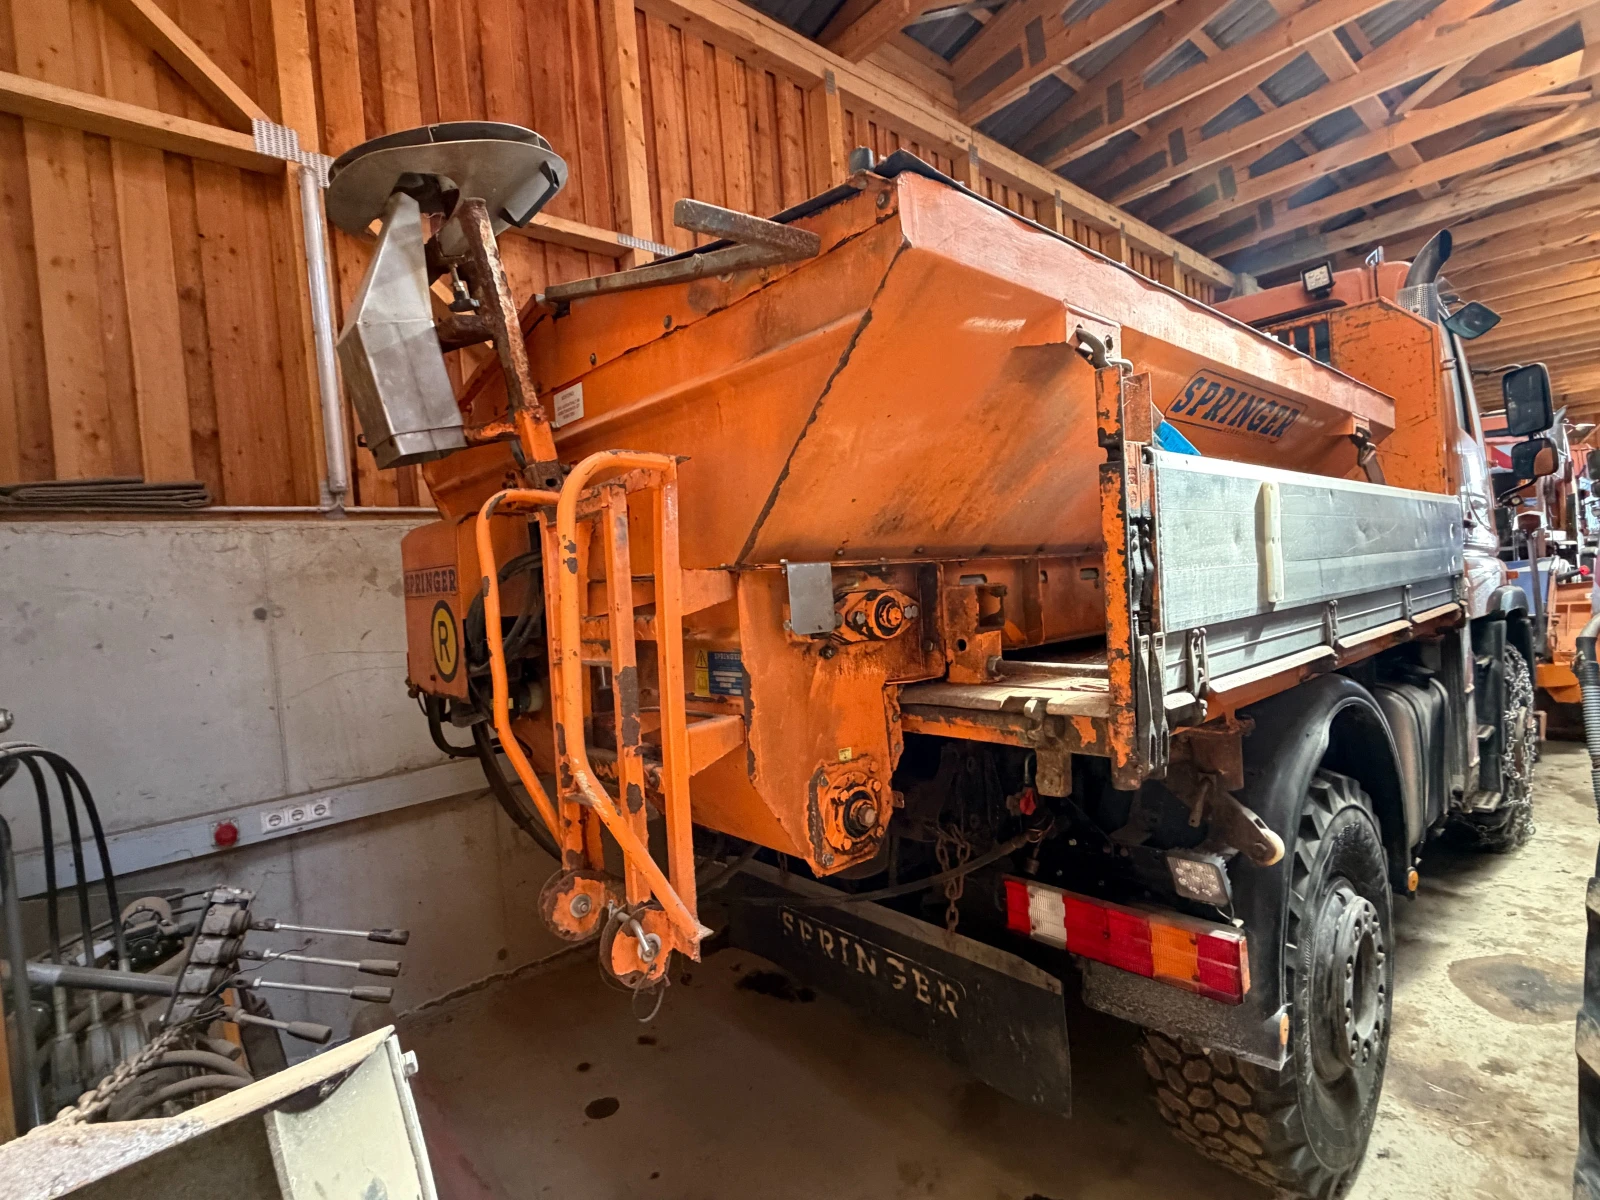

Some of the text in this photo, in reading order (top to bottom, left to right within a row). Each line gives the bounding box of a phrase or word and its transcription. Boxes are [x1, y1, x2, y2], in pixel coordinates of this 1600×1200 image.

[1171, 377, 1301, 437] SPRINGER
[405, 569, 457, 592] SPRINGER
[438, 620, 451, 662] R
[780, 911, 960, 1019] SPRINGER
